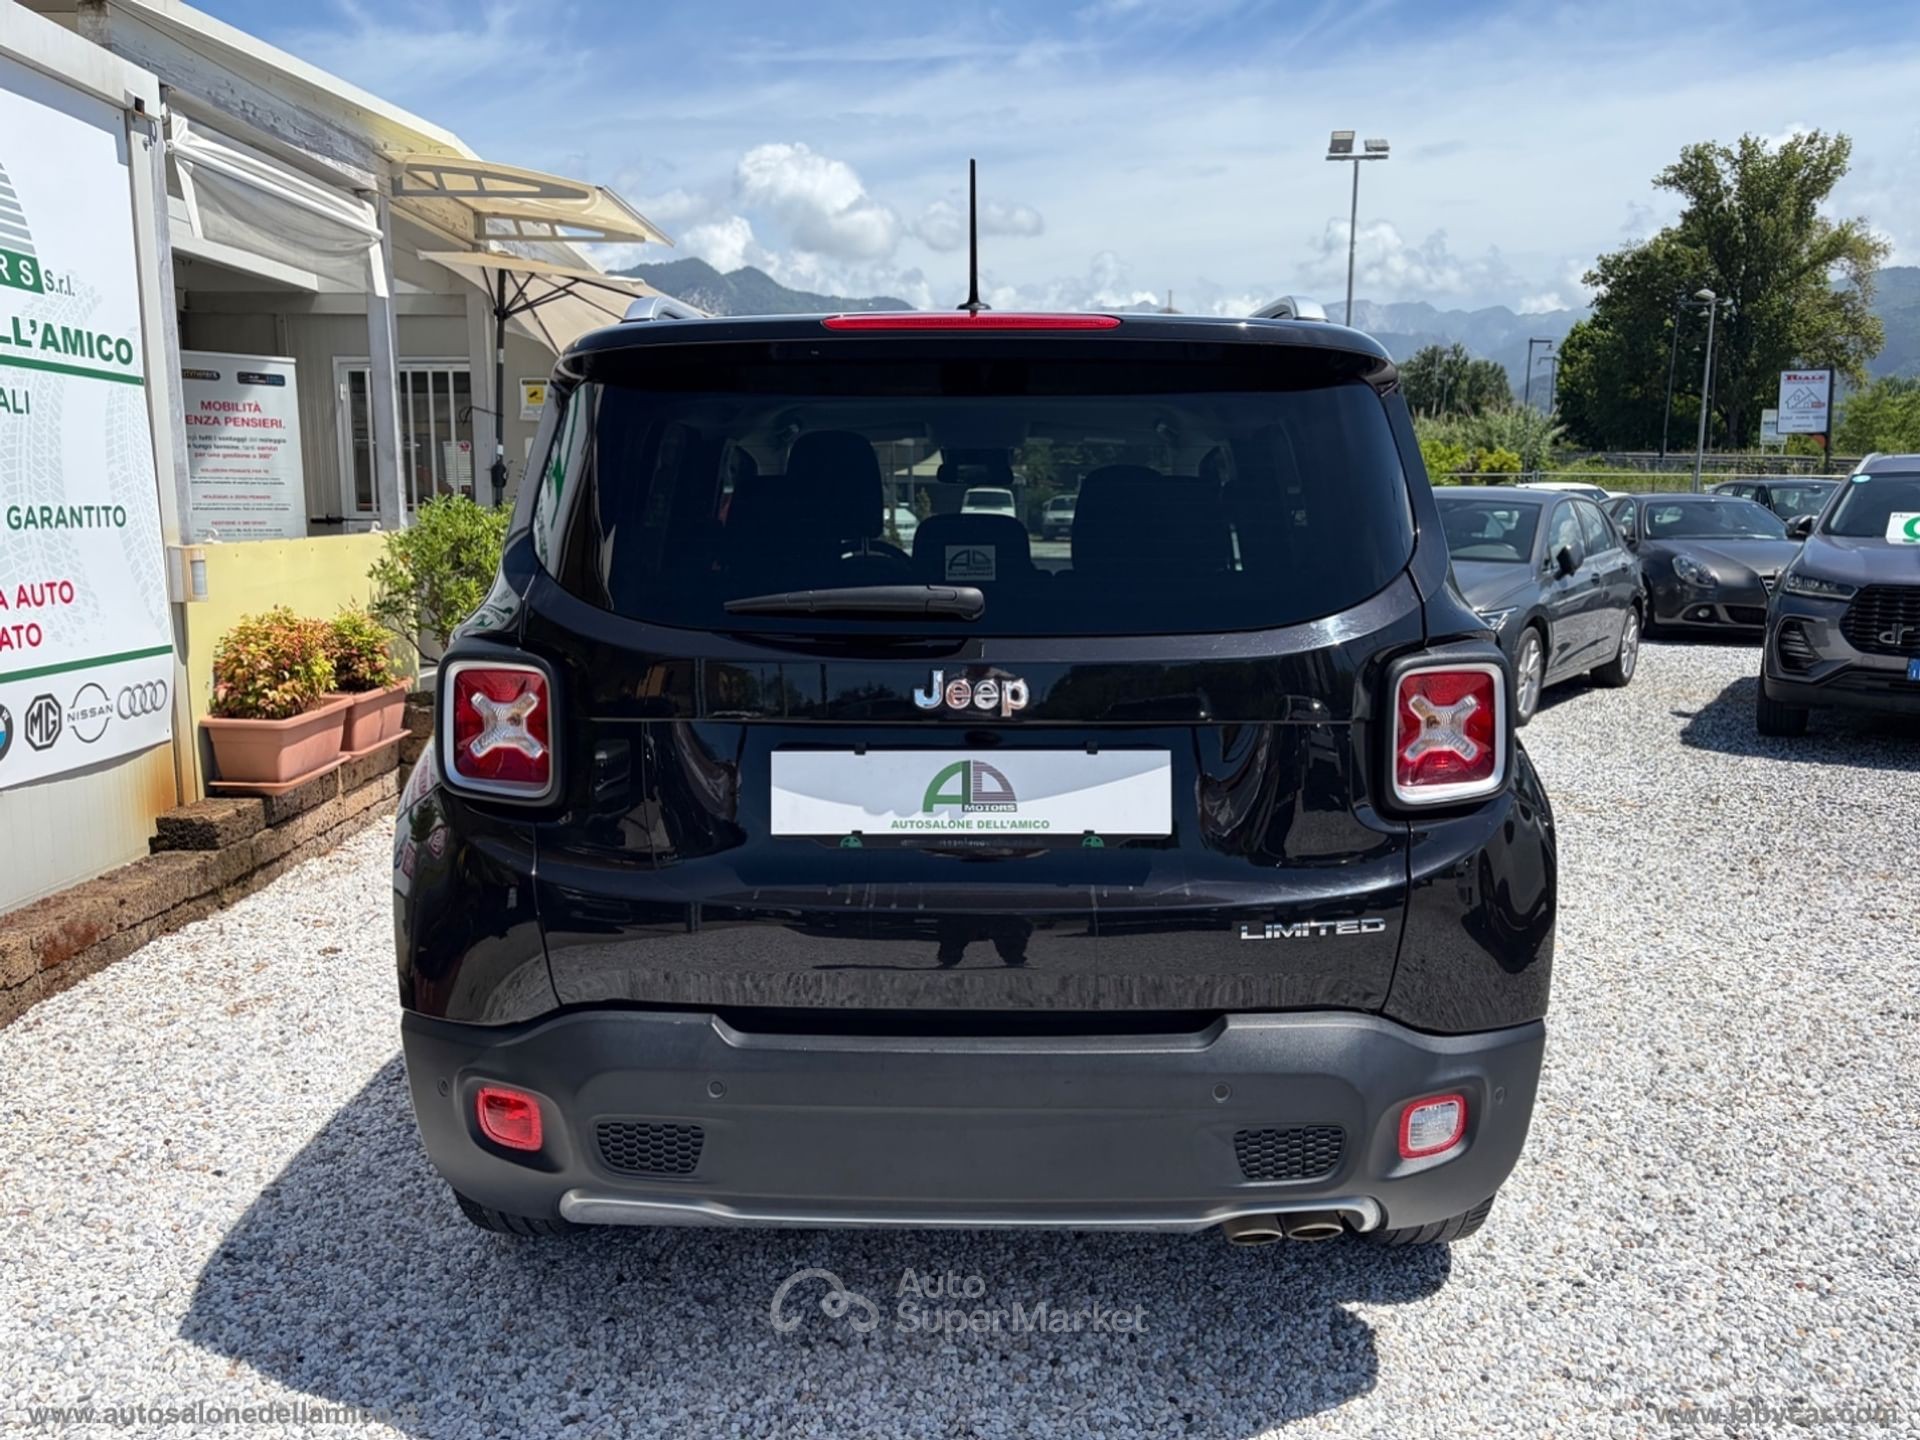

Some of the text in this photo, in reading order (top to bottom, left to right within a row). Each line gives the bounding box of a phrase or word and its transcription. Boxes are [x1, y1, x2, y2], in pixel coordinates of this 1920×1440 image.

[44, 269, 76, 297] S.r.l.
[200, 400, 262, 413] MOBILITÀ
[185, 414, 286, 429] ENZA PENSIERI.
[6, 505, 127, 530] GARANTITO
[16, 580, 75, 609] AUTO
[913, 669, 1030, 717] Jeep
[29, 701, 58, 743] MG
[67, 703, 114, 723] NISSAN
[963, 803, 1017, 812] MOTORS
[891, 819, 1050, 830] AUTOSALONE DELL'AMICO
[1240, 918, 1387, 940] LIMITED
